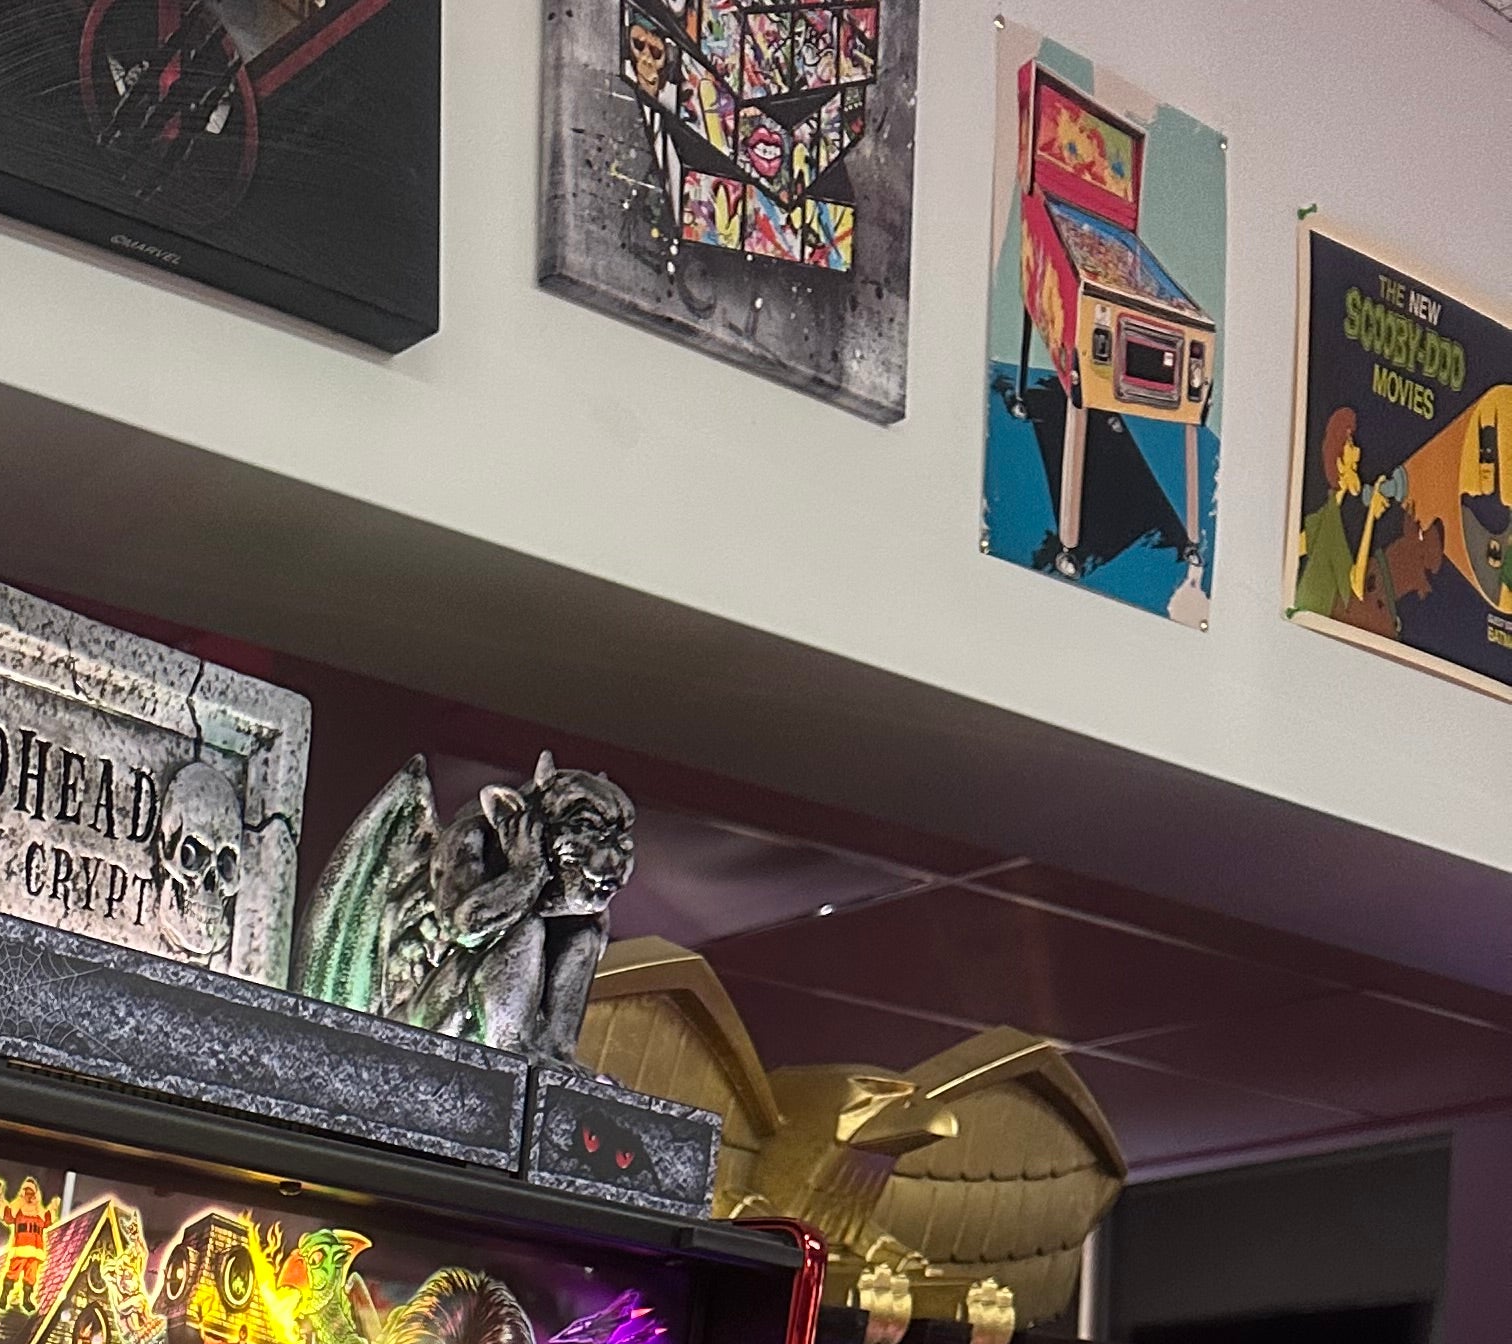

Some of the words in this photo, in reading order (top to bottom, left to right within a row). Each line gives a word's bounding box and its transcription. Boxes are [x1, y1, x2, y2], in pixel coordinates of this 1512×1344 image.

[1378, 274, 1407, 308] THE
[1408, 290, 1442, 326] NEW
[1343, 286, 1467, 392] SCOOBY-DOO
[1372, 362, 1436, 421] MOVIES
[24, 841, 155, 927] CRYPT
